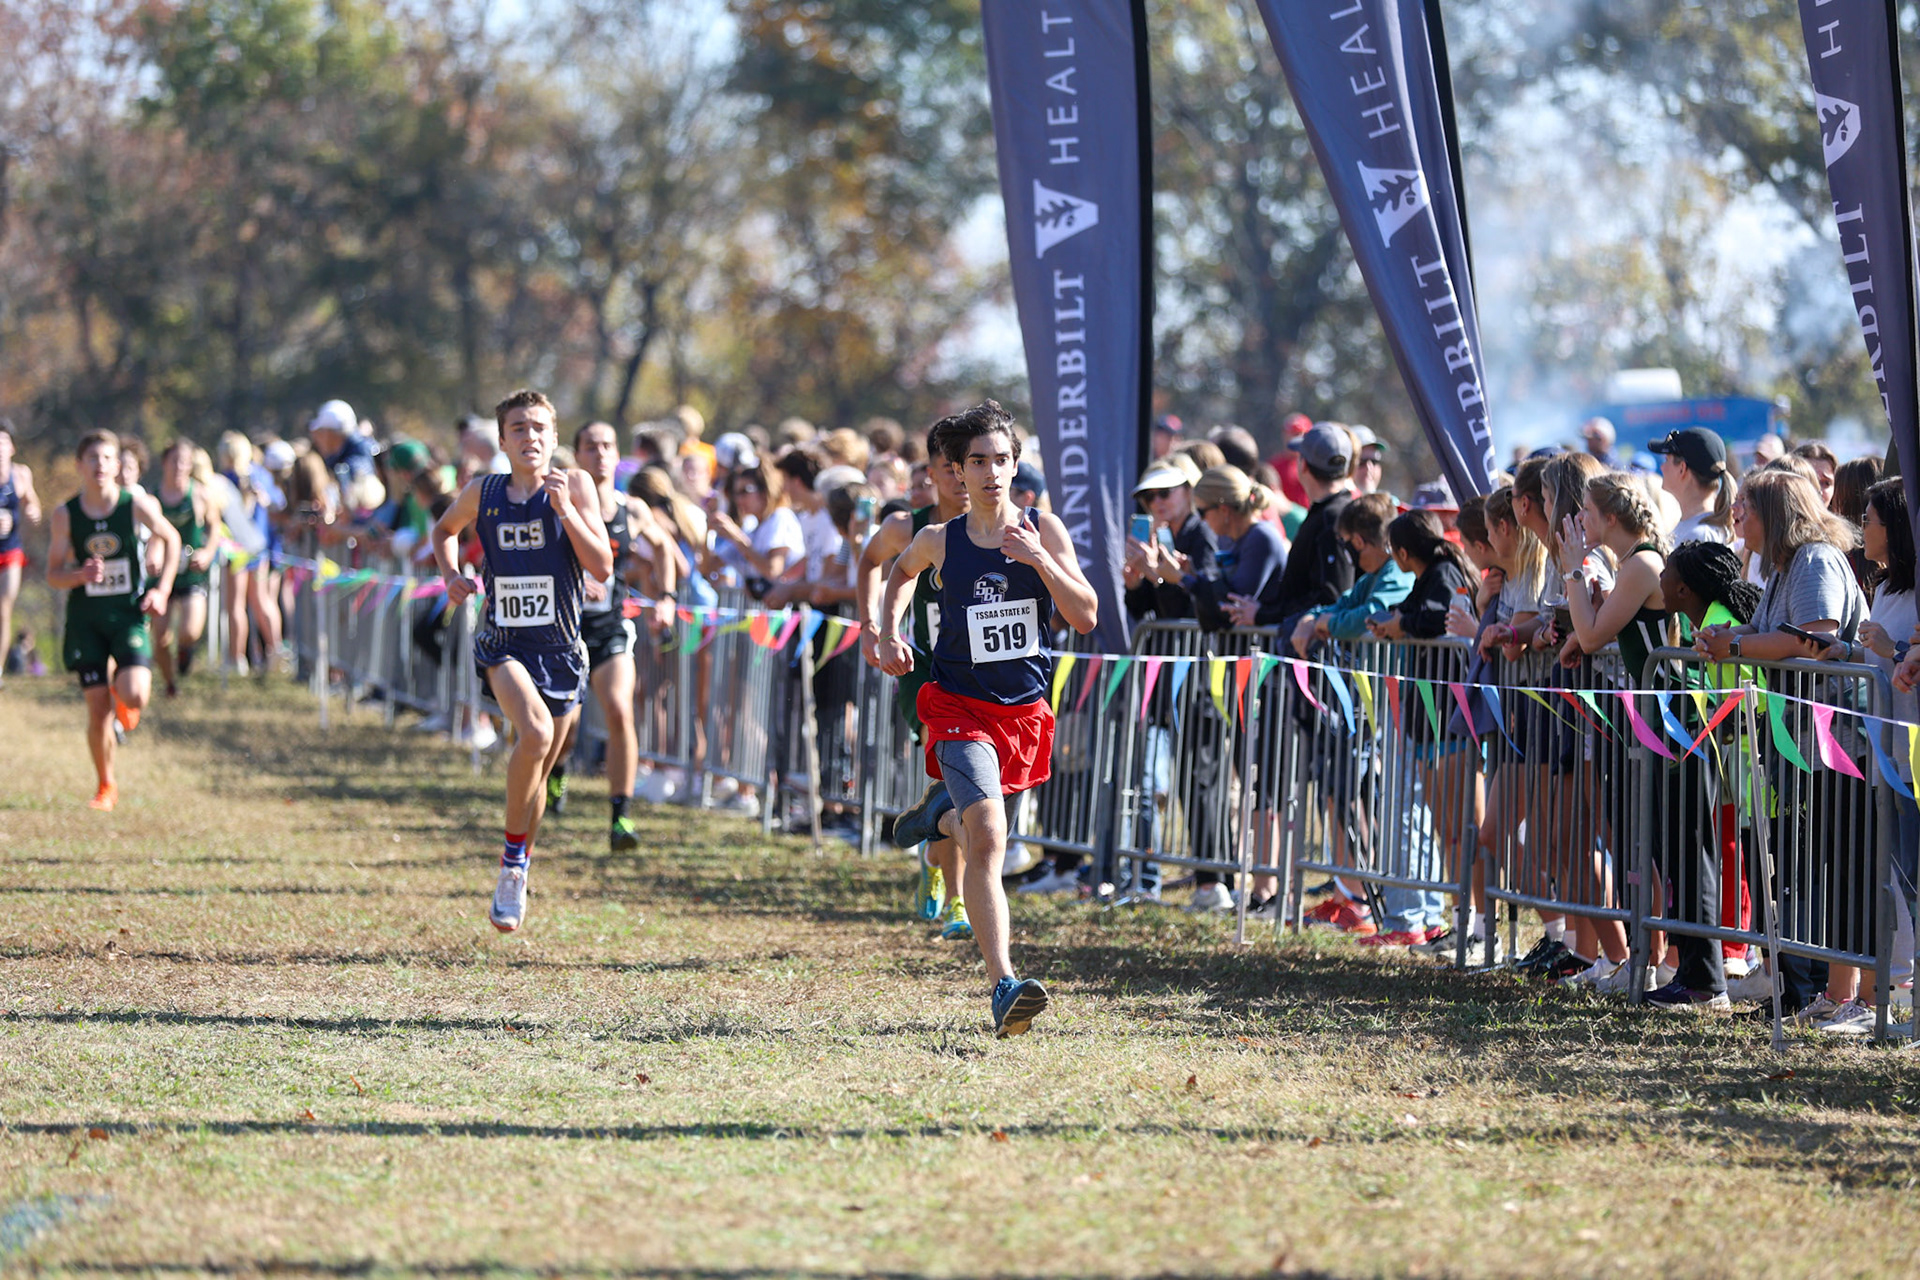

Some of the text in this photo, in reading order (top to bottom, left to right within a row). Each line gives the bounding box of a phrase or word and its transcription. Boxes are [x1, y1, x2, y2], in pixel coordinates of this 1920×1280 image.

[497, 518, 546, 550] CCS
[500, 594, 549, 619] 1052
[975, 606, 1031, 620] TSSAA STATE XC
[982, 622, 1027, 653] 519
